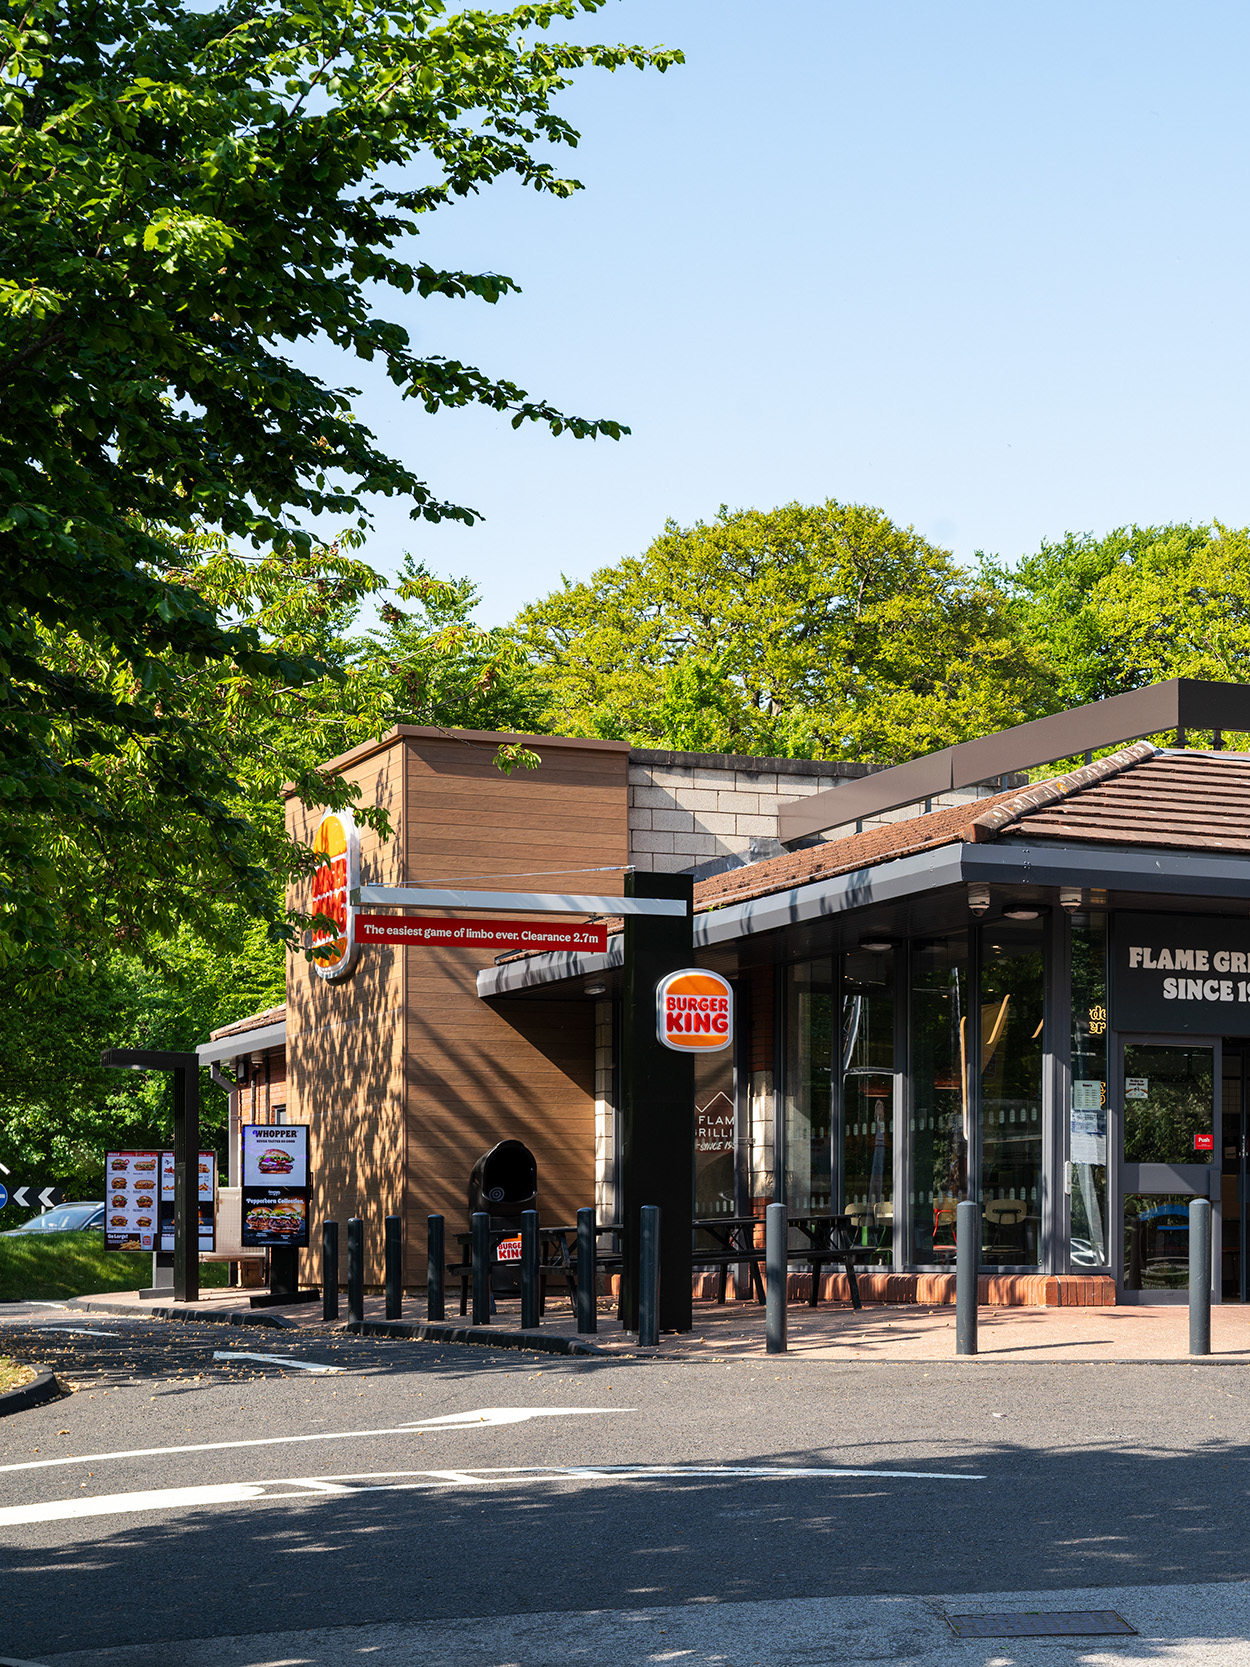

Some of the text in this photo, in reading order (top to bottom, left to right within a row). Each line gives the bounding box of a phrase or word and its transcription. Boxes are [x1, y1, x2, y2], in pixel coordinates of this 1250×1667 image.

[363, 924, 599, 943] The easiest game of limbo ever. Clearance 2.7m
[1129, 946, 1210, 972] FLAME
[1163, 977, 1234, 1002] SINCE
[666, 996, 729, 1012] BURGER
[666, 1011, 729, 1034] KING
[252, 1129, 298, 1138] WHOPPER
[695, 1128, 732, 1138] RILLI
[498, 1249, 522, 1259] KIN
